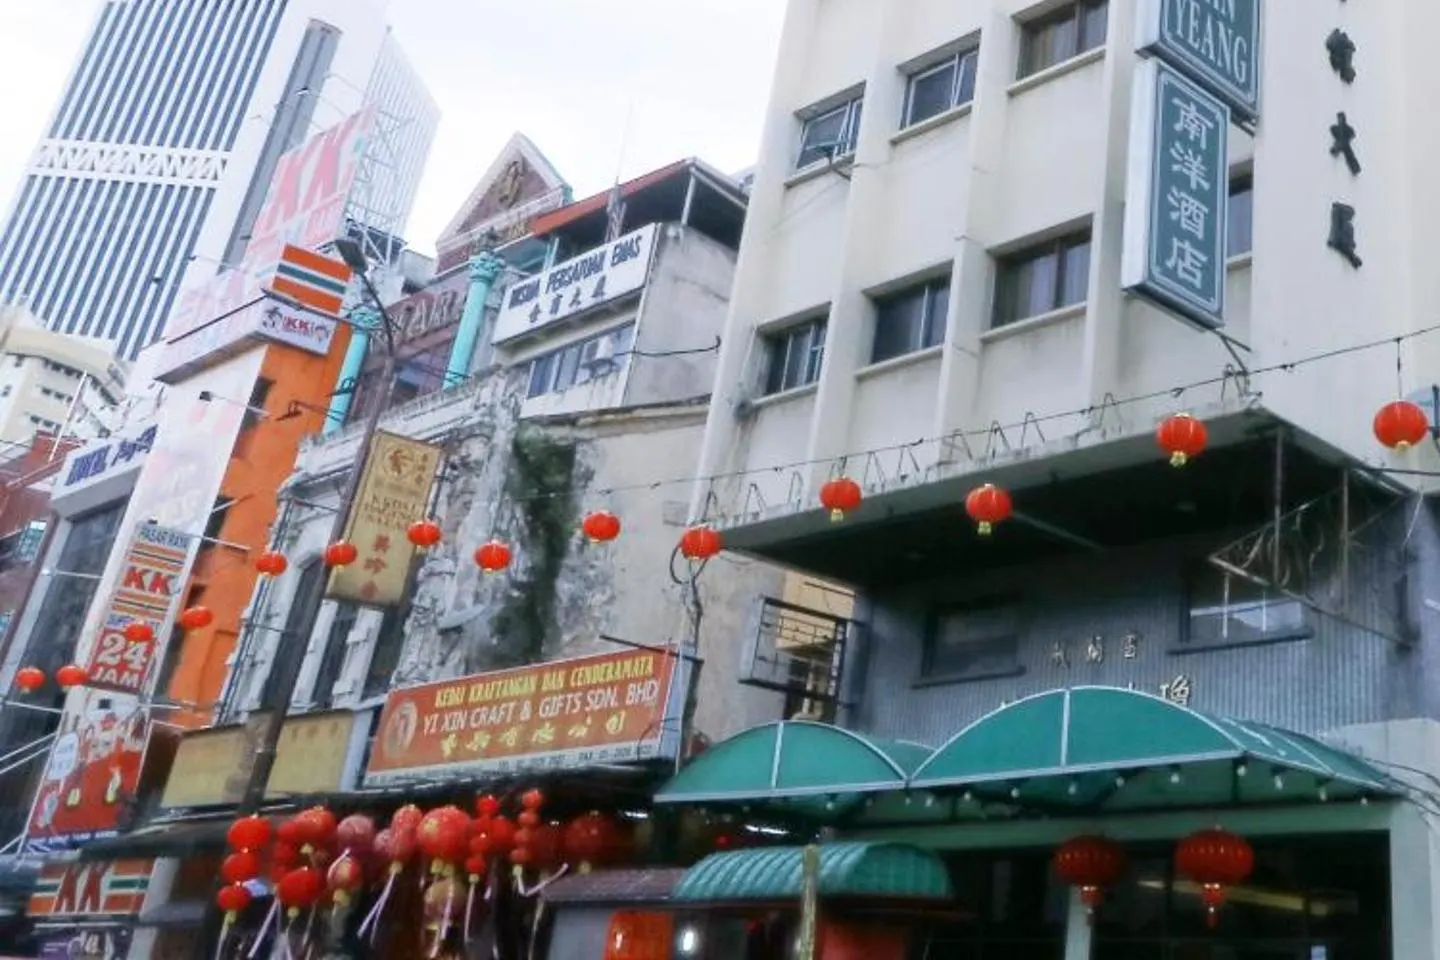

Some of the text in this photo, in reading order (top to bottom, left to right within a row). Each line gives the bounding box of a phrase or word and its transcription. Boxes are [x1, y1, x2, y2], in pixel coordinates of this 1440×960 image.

[1166, 96, 1214, 289] 南洋酒店
[123, 565, 175, 596] KK
[96, 633, 149, 672] 24
[91, 666, 141, 689] JAM
[422, 711, 438, 734] YI
[440, 708, 467, 733] XIN
[469, 701, 516, 728] CRAFT
[520, 699, 532, 720] &
[538, 691, 582, 718] GIFTS
